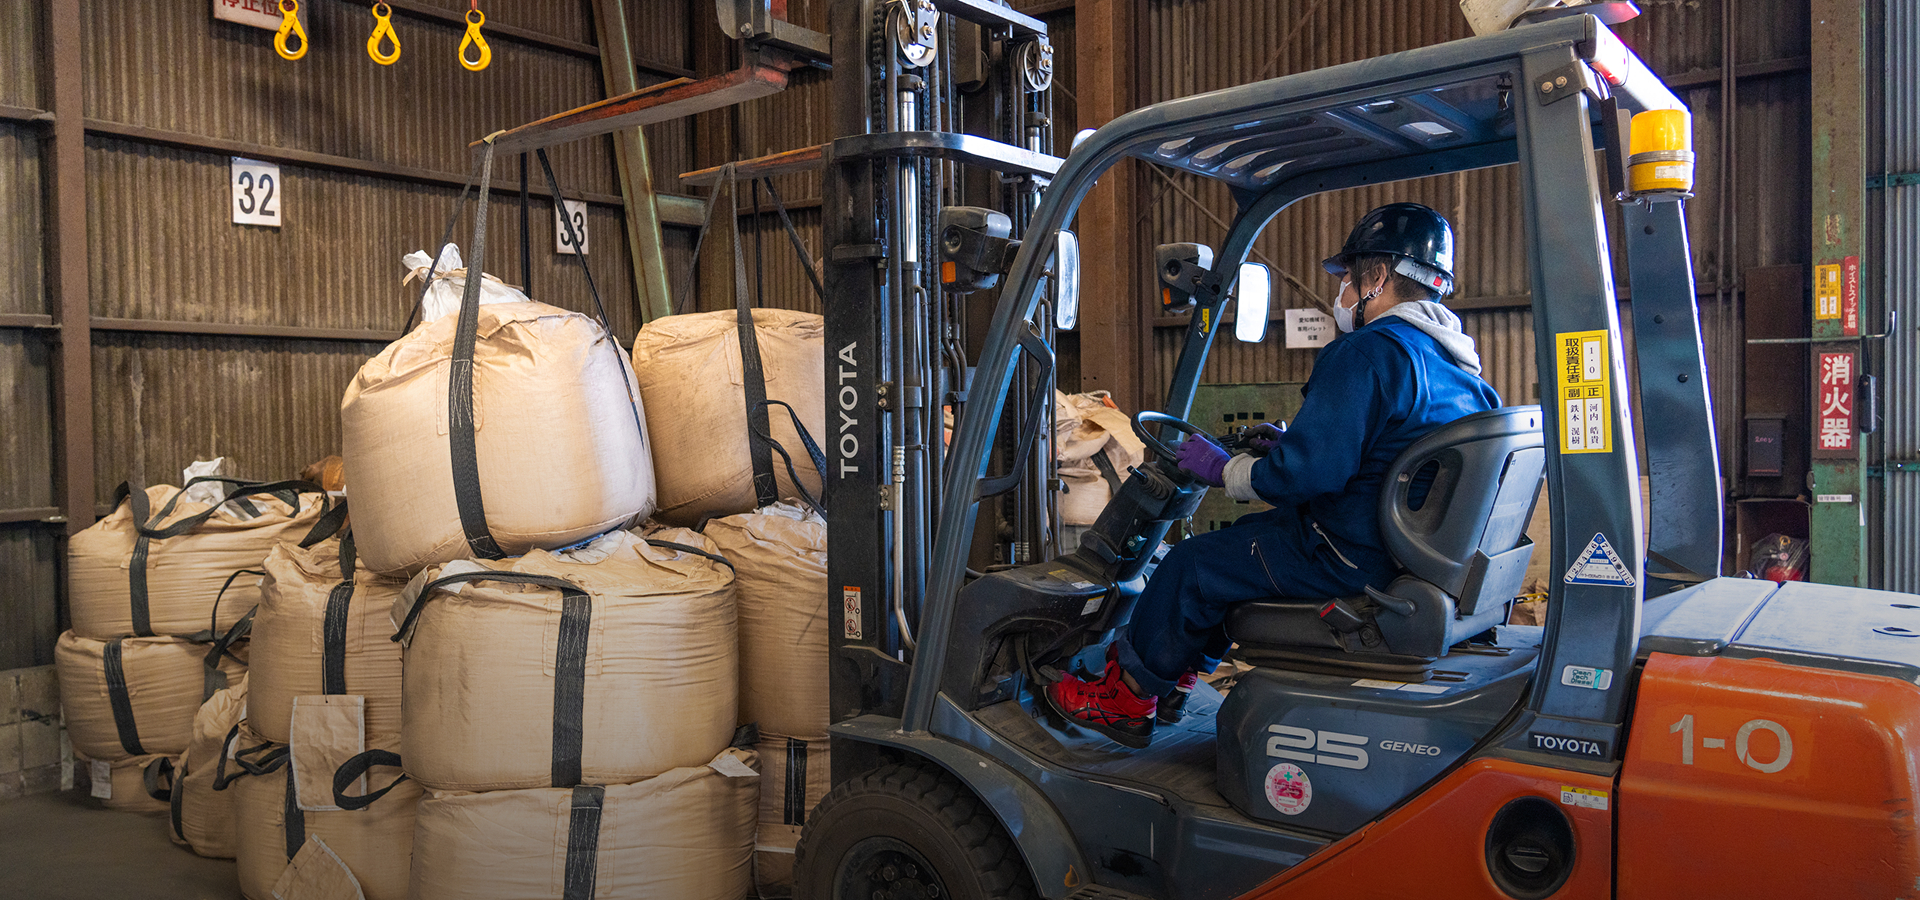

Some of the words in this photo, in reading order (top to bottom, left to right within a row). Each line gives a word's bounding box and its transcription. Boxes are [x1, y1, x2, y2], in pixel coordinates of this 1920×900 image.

[238, 171, 275, 217] 32
[560, 211, 585, 247] 33
[1565, 338, 1580, 384] 取扱責任者
[838, 340, 859, 479] TOYOTA
[1568, 388, 1580, 398] 副
[1587, 387, 1600, 397] 正
[1820, 355, 1851, 447] 消火器
[1589, 403, 1599, 421] 河内
[1625, 577, 1633, 585] 12
[1266, 723, 1369, 770] 25
[1379, 740, 1441, 756] GENEO
[1534, 735, 1601, 755] TOYOTA
